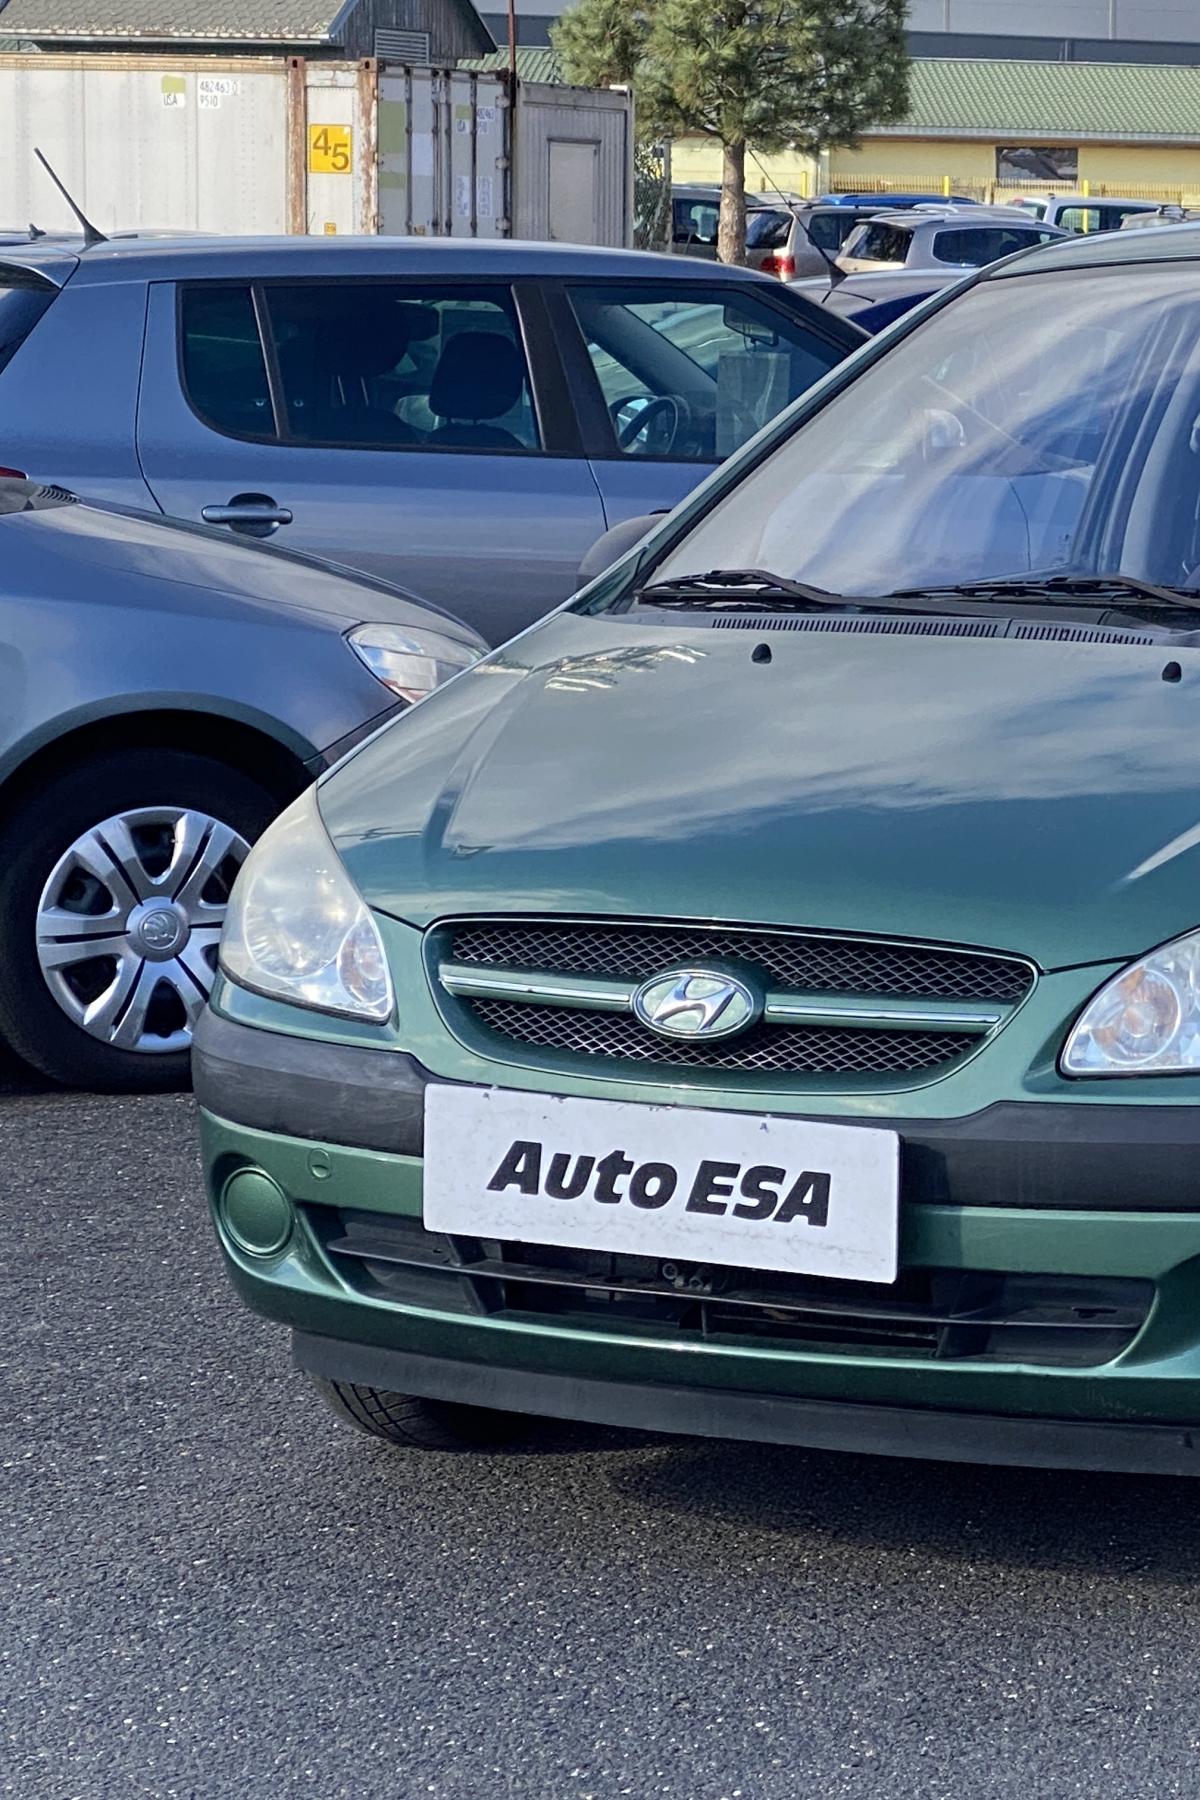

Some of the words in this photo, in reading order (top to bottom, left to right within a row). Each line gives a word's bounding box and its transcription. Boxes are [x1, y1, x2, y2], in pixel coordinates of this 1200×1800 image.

[312, 127, 350, 171] 45
[486, 1139, 678, 1210] Auto
[685, 1159, 833, 1228] ESA
